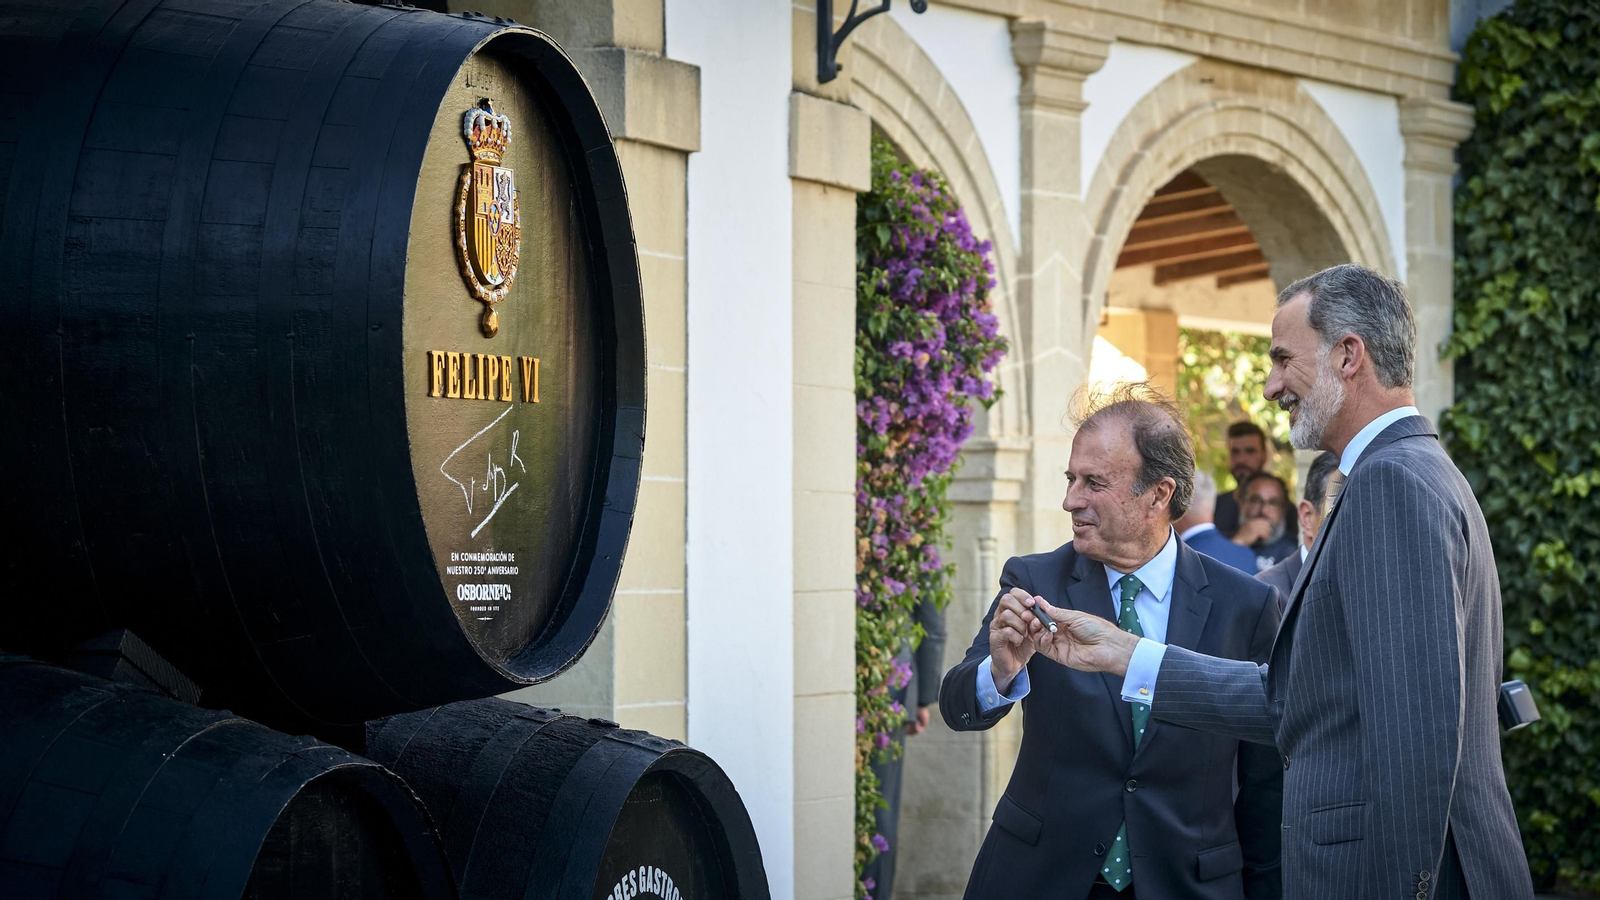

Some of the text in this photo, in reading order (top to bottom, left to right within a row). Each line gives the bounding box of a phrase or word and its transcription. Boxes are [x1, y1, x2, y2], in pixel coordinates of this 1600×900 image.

[428, 350, 540, 403] FELIPE VI
[451, 551, 515, 562] EN CONMEMORACIÓN DE
[446, 566, 473, 575] NUESTRO
[487, 566, 519, 575] ANIVERSARIO
[639, 865, 684, 900] GASTRO
